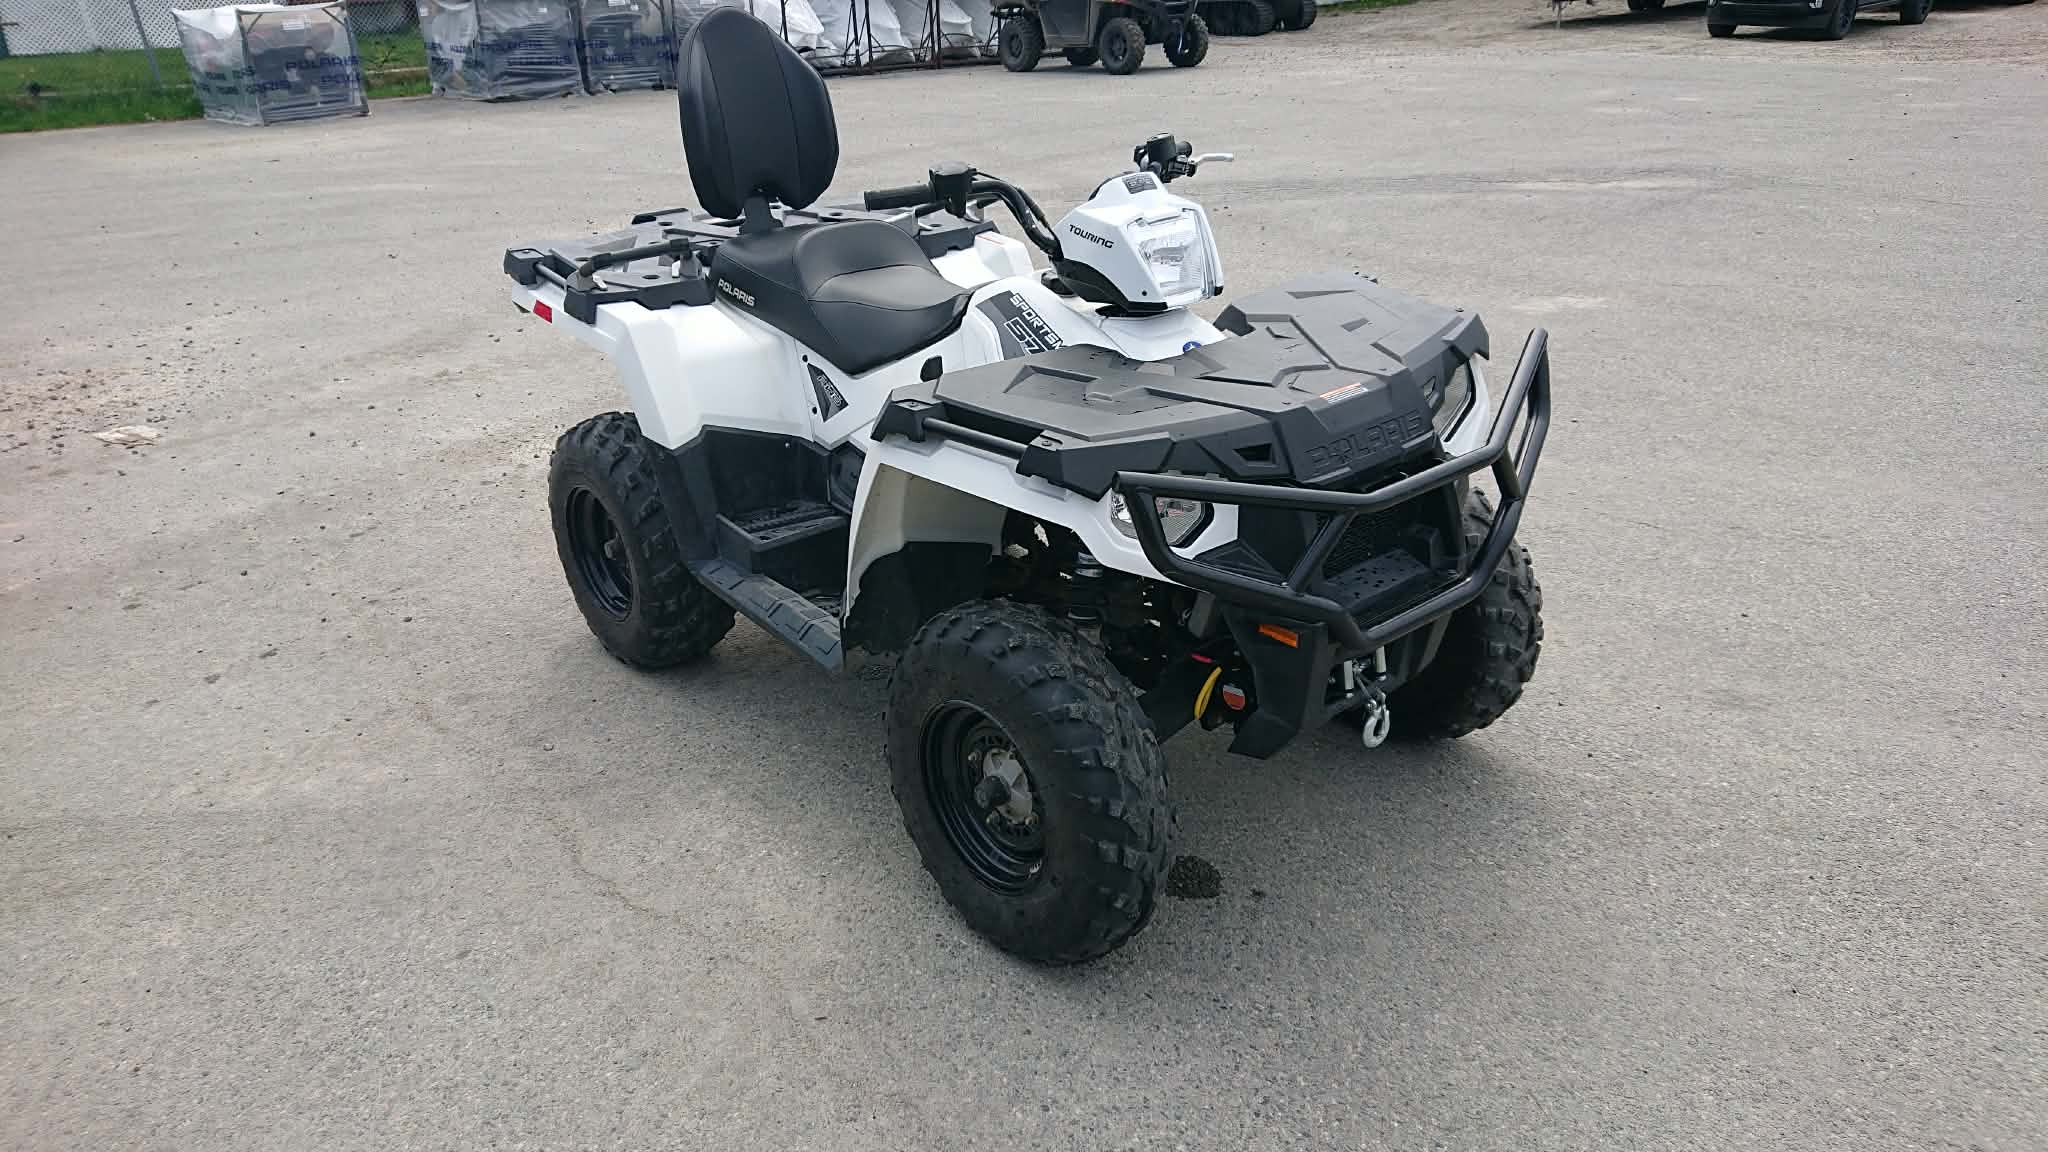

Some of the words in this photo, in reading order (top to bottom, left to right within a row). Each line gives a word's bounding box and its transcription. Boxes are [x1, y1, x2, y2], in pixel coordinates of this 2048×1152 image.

[1068, 223, 1115, 249] TOURING
[718, 277, 756, 307] POLARIS
[1303, 409, 1425, 477] POLARIS
